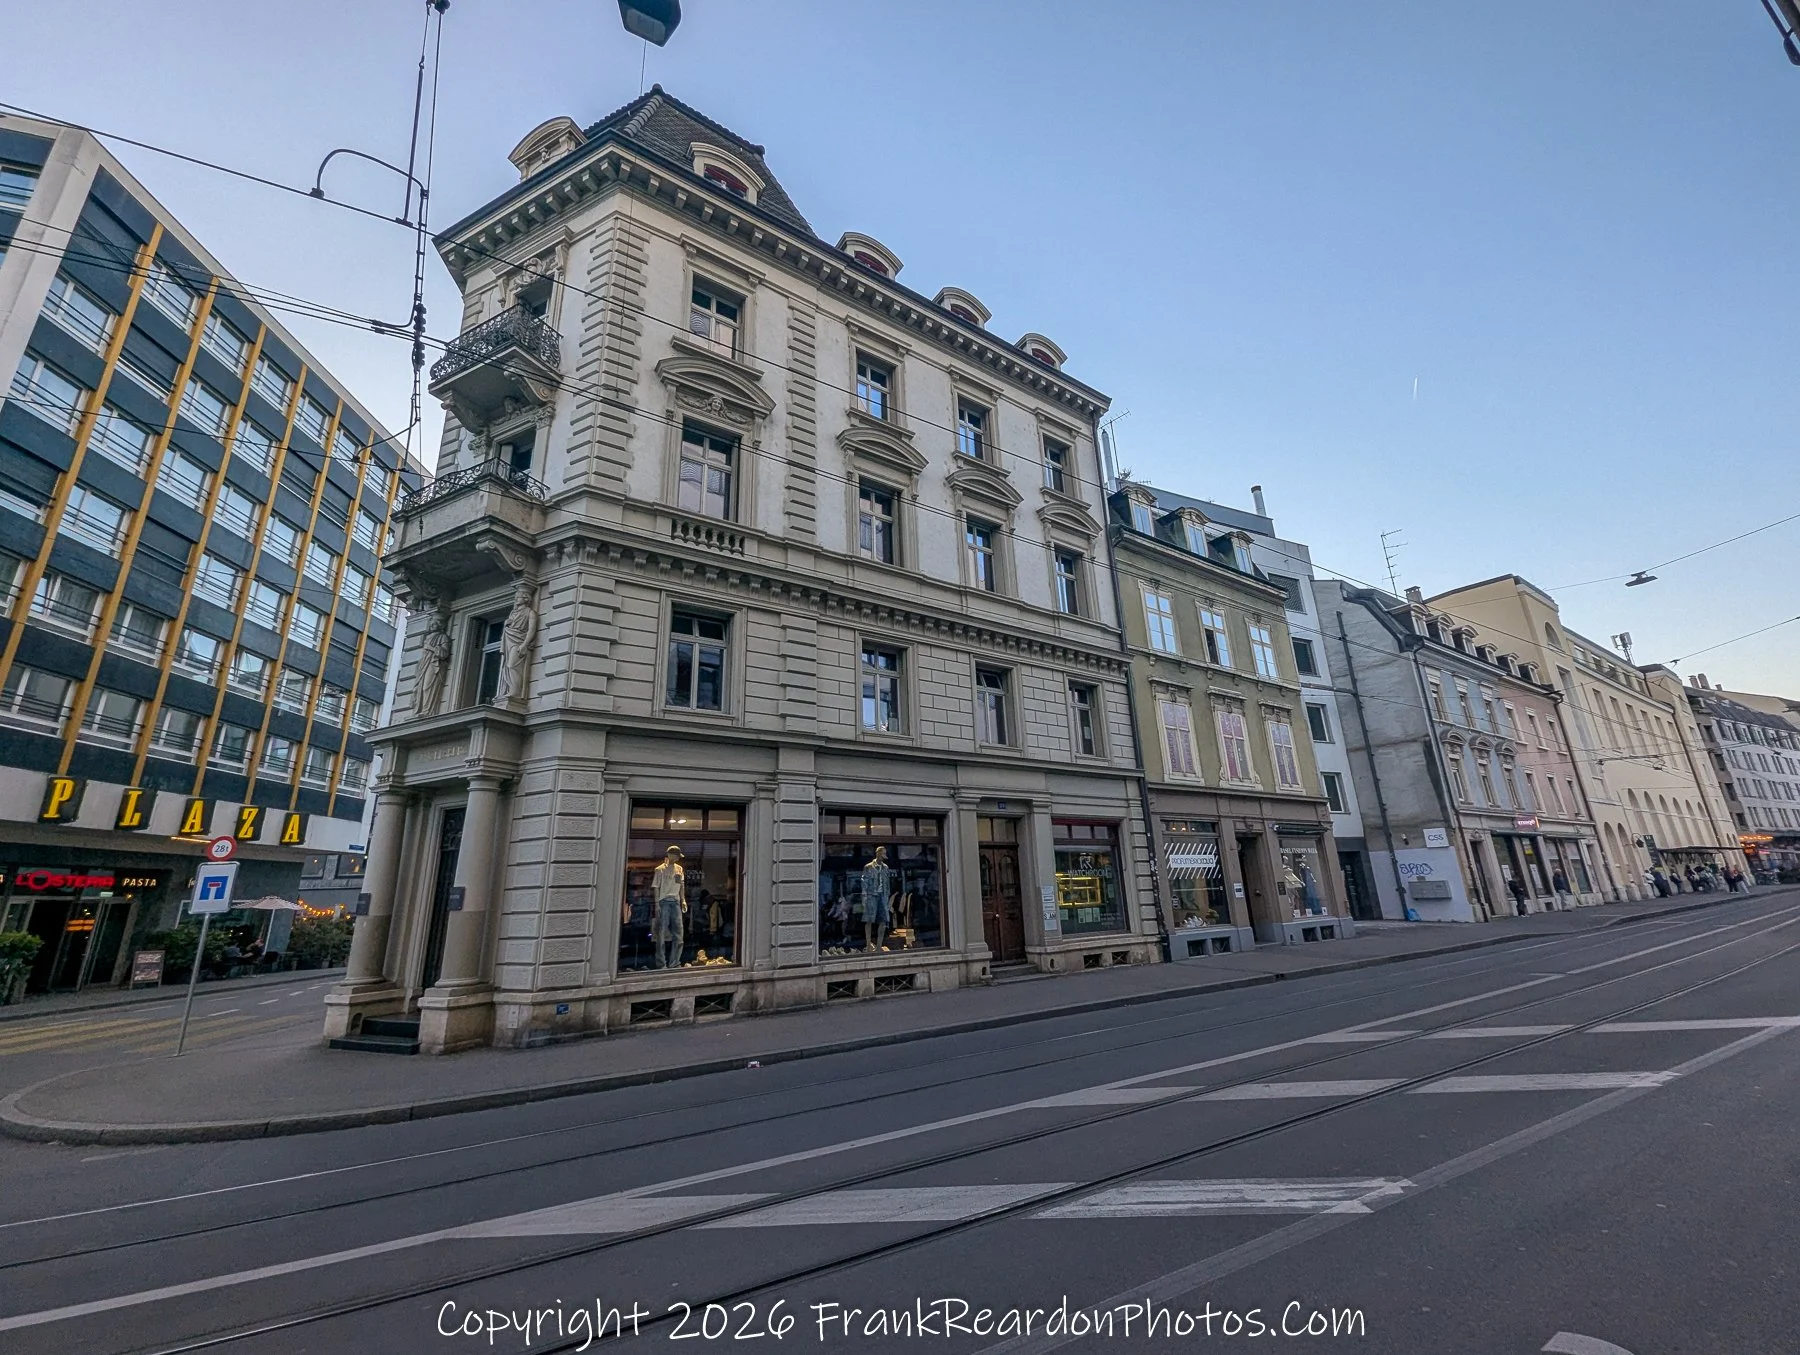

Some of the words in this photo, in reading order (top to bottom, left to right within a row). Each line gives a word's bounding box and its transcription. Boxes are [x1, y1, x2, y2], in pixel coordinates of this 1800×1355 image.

[43, 779, 300, 843] PLAZA
[1427, 834, 1444, 842] CSS
[122, 877, 157, 887] PASTA
